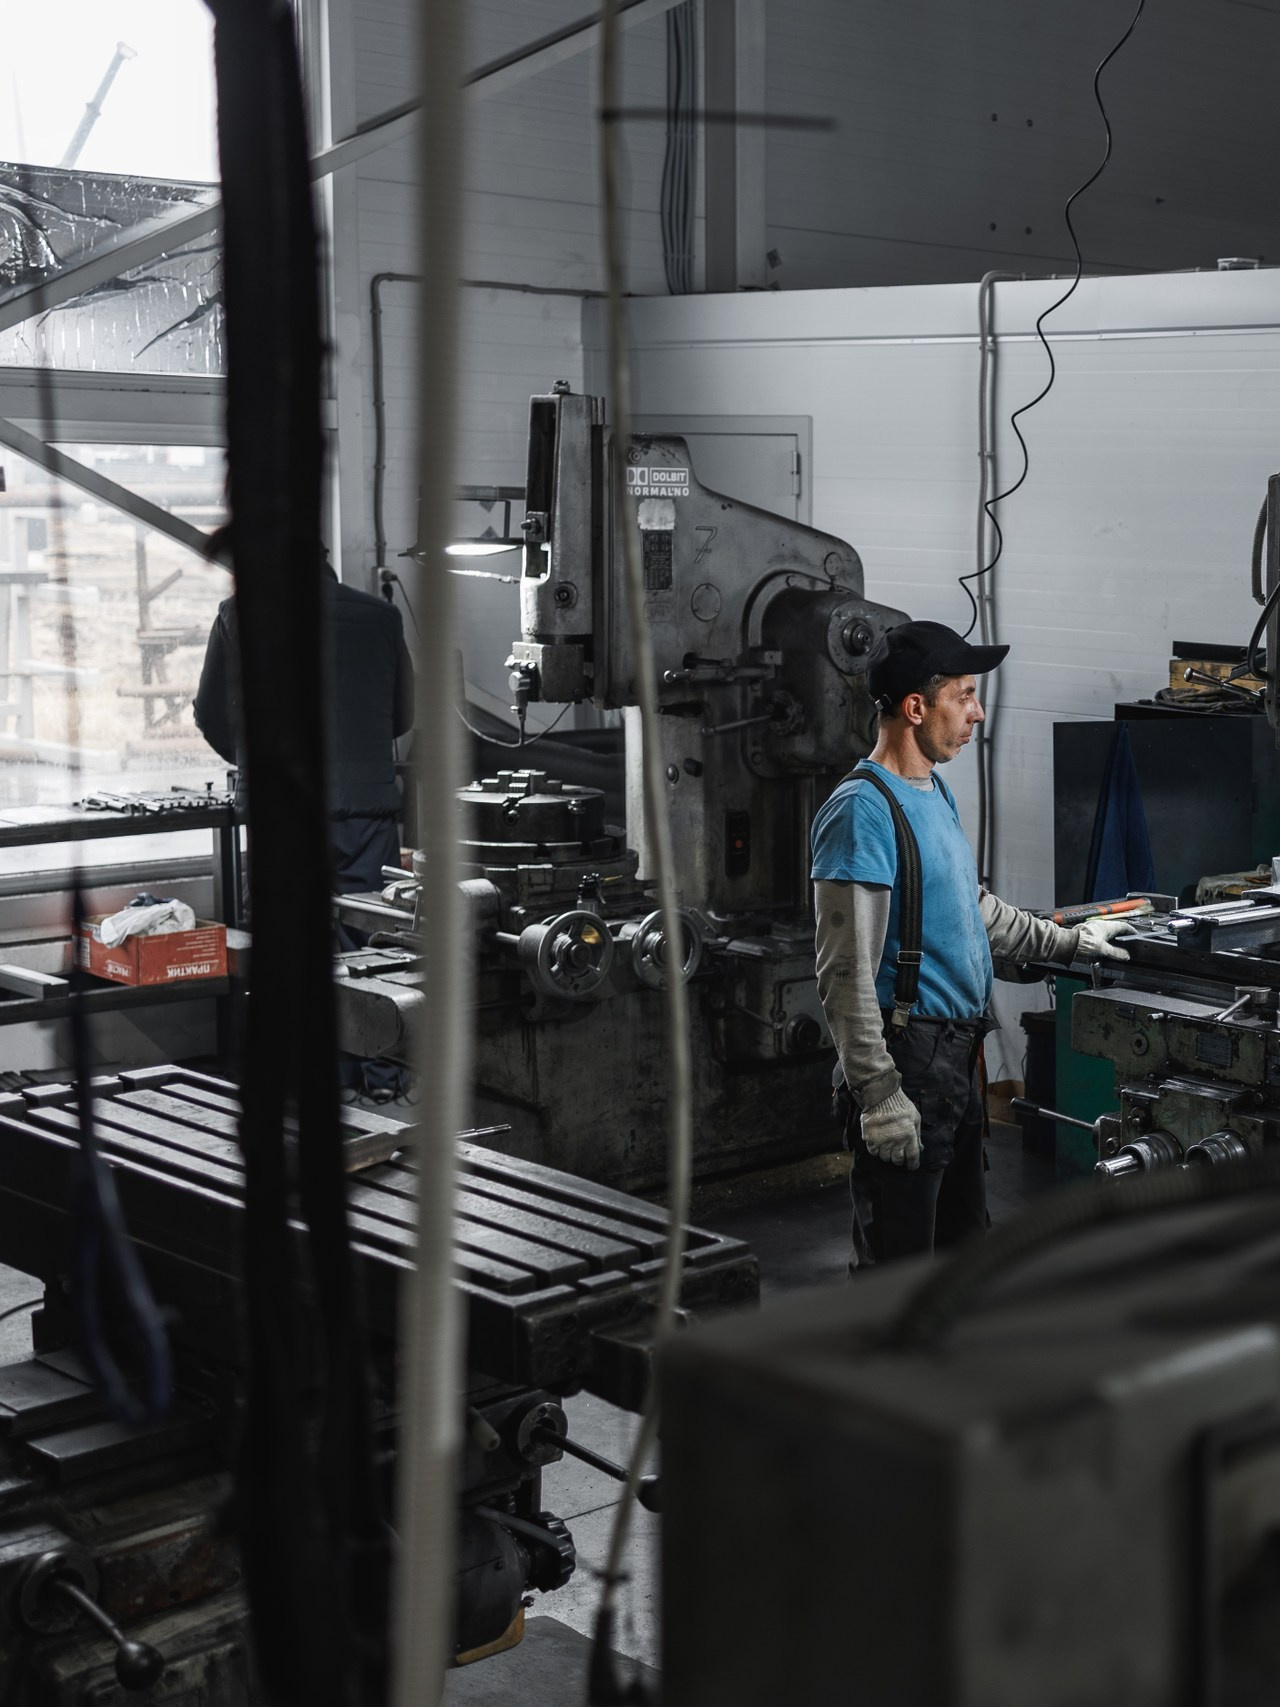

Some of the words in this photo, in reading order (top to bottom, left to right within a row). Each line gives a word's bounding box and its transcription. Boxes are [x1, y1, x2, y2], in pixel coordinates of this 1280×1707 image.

[652, 472, 686, 482] DOLBIT
[627, 486, 690, 497] NORMAL'NO
[167, 963, 211, 978] ПРАКТИК
